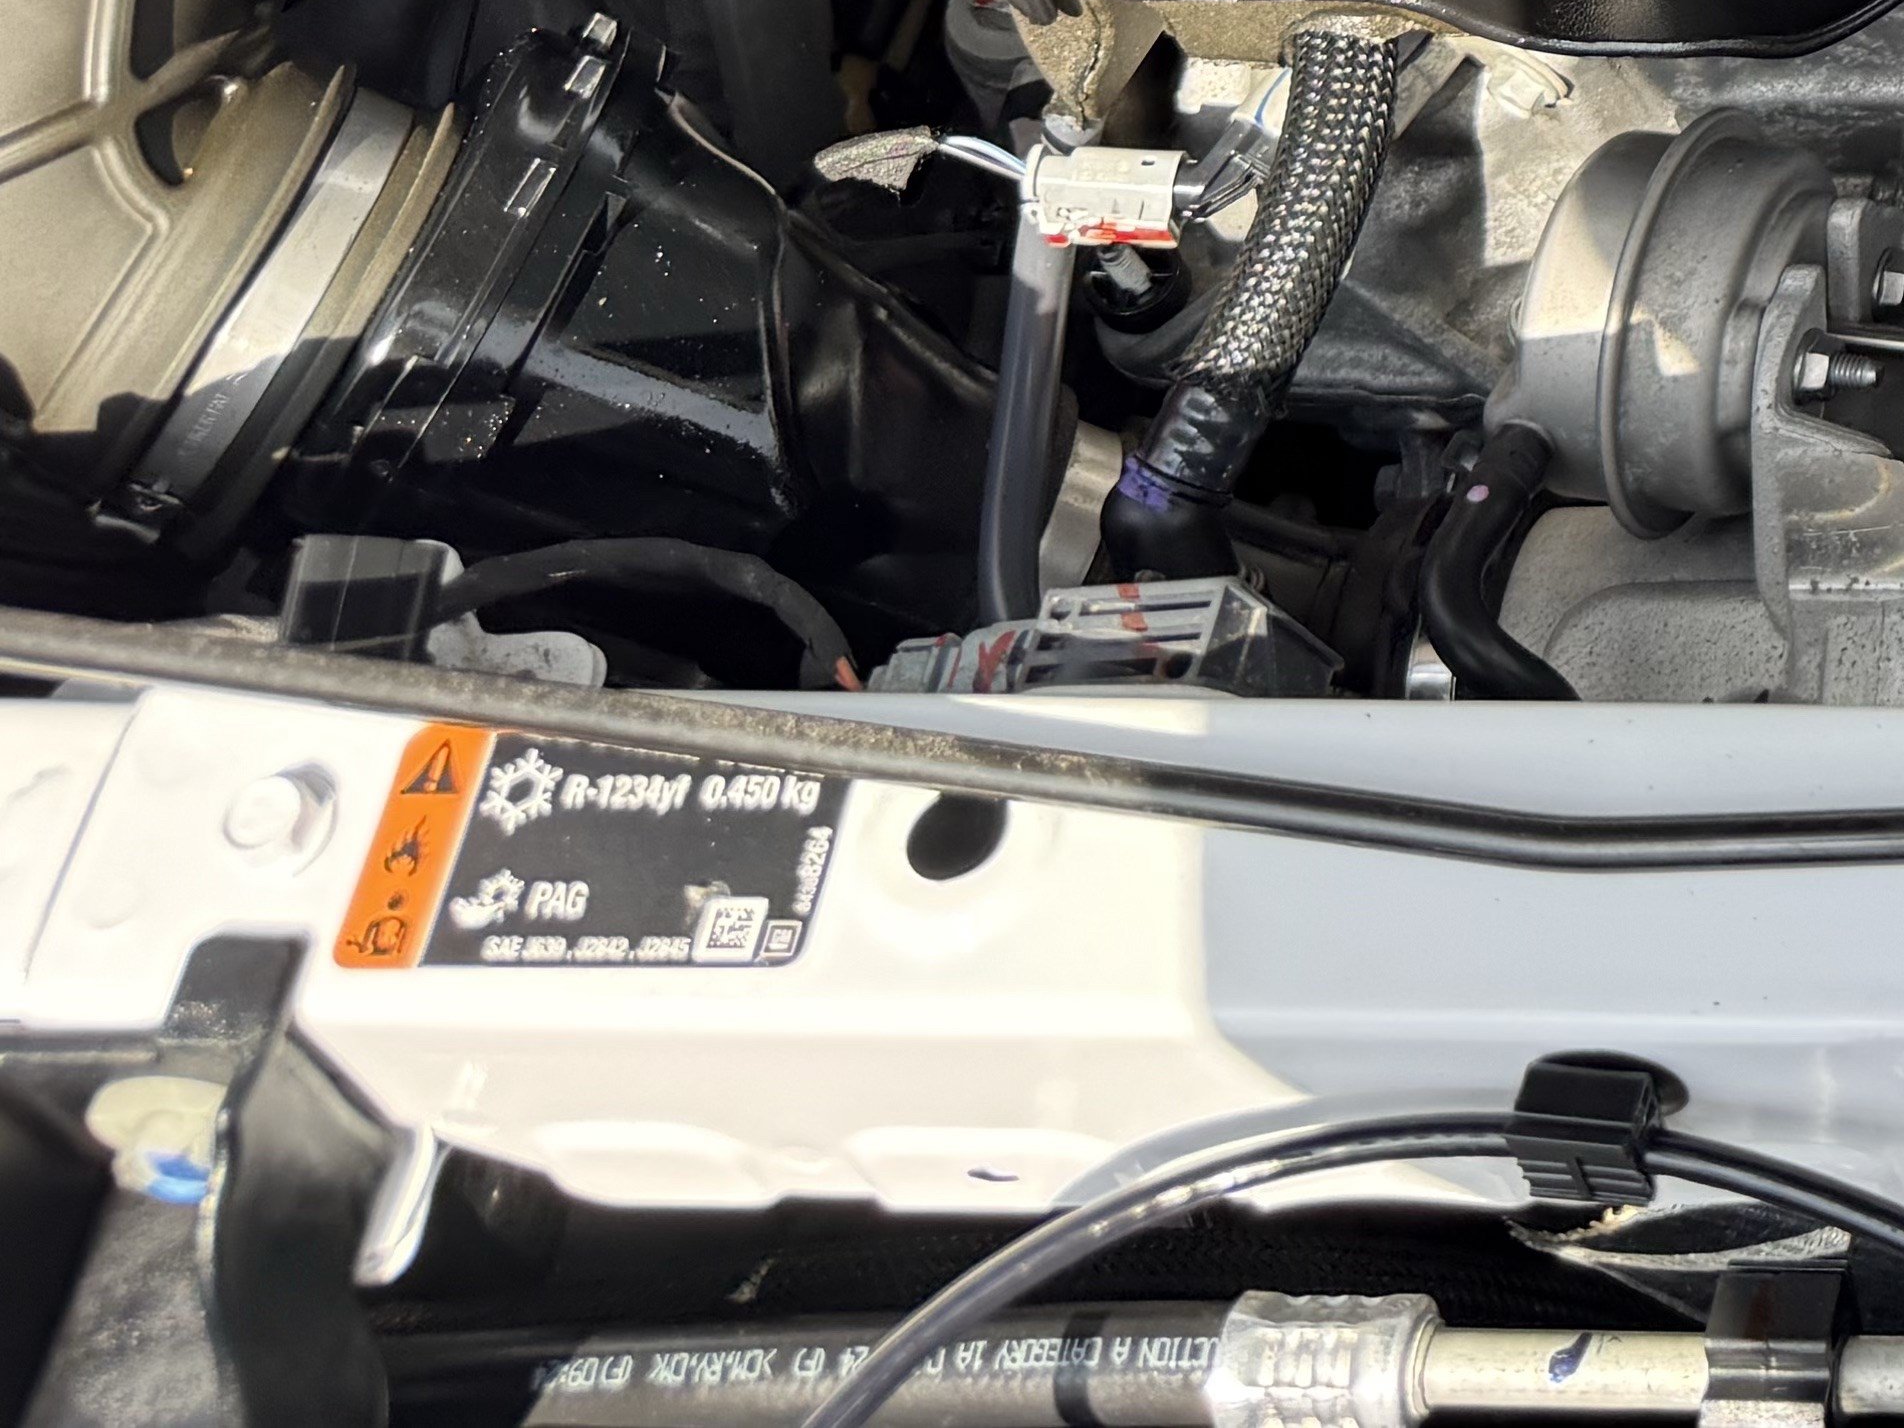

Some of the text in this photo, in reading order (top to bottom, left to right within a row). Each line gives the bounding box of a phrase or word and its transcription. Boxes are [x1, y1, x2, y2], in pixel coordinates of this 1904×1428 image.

[561, 773, 822, 816] R-1234yf 0.450 kg
[523, 879, 590, 921] PAG
[479, 934, 523, 963] SAE
[993, 1335, 1104, 1372] CATEGORY
[1111, 1335, 1132, 1366] A
